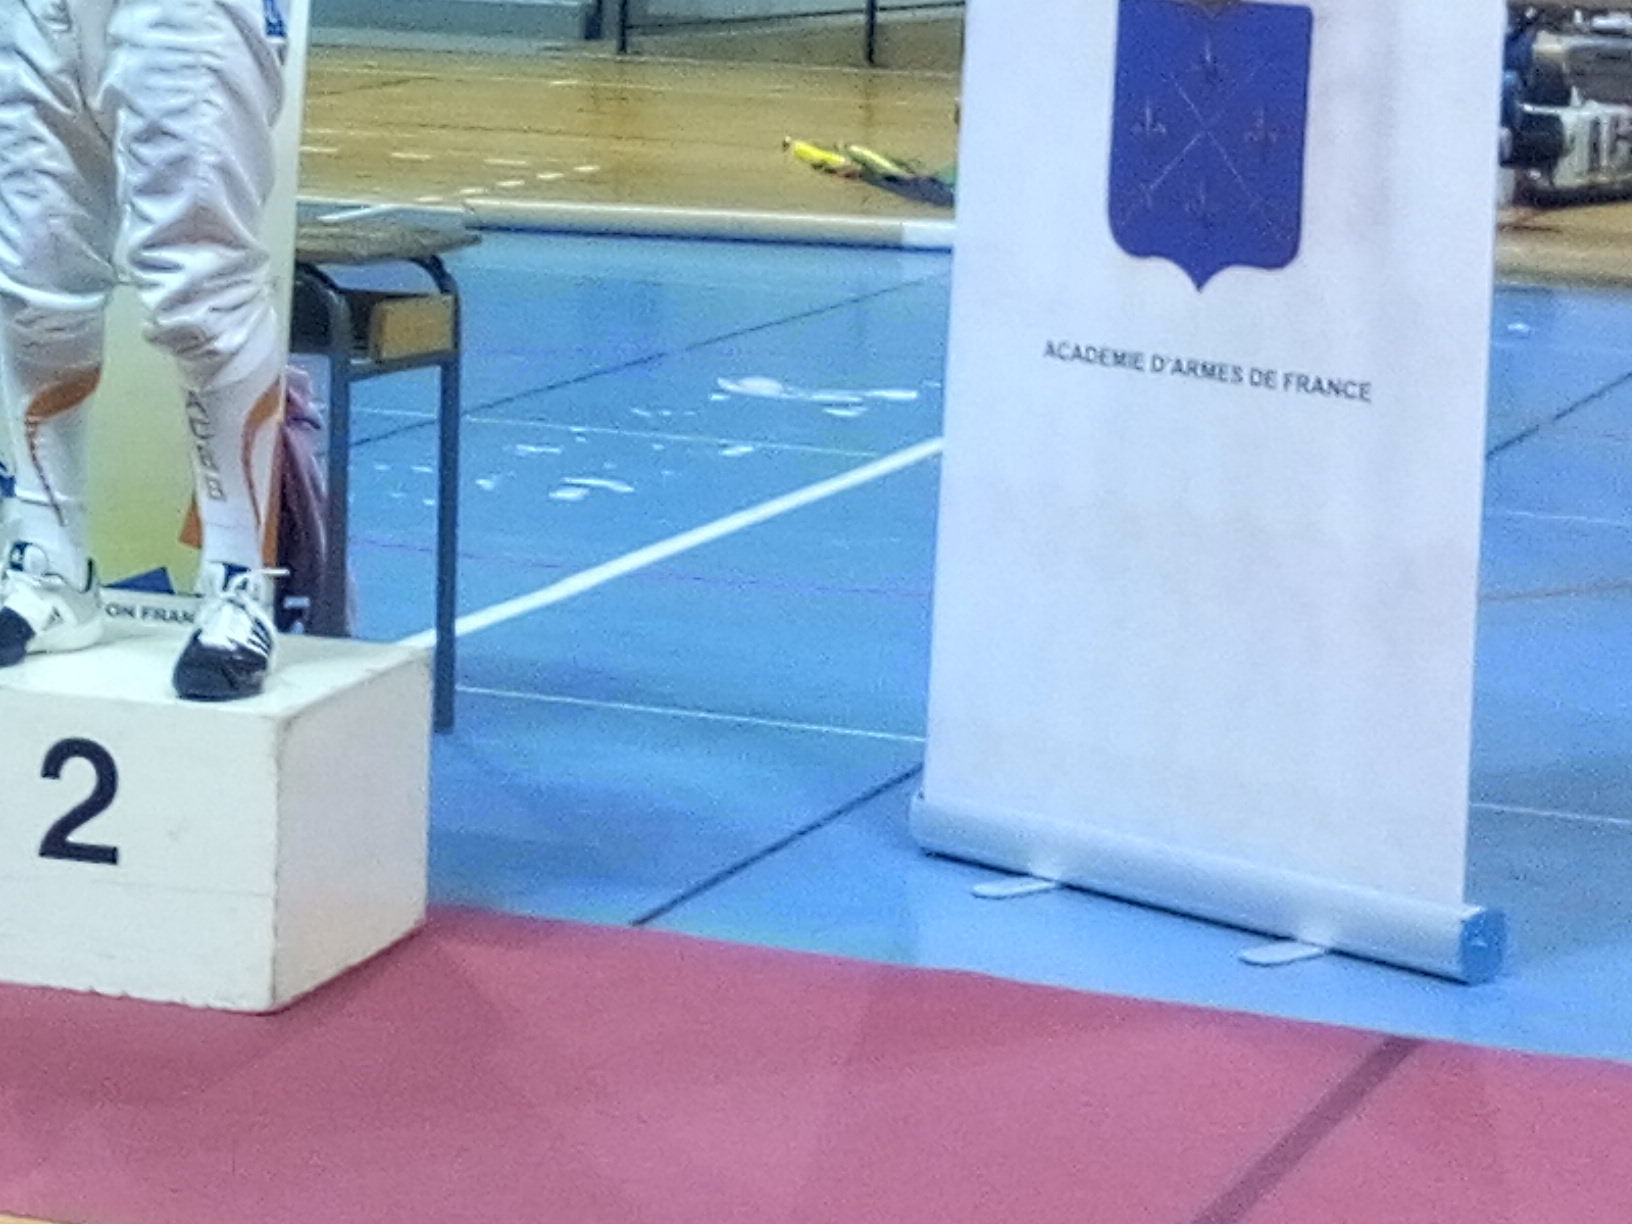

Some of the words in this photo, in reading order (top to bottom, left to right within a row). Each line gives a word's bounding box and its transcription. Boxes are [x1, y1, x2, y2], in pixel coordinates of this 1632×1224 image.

[1043, 339, 1145, 373] ACADEMIE
[1150, 353, 1244, 384] D'ARMES
[1249, 366, 1277, 390] DE
[1282, 371, 1372, 404] FRANCE
[141, 605, 195, 625] FRAN
[38, 736, 119, 865] 2
